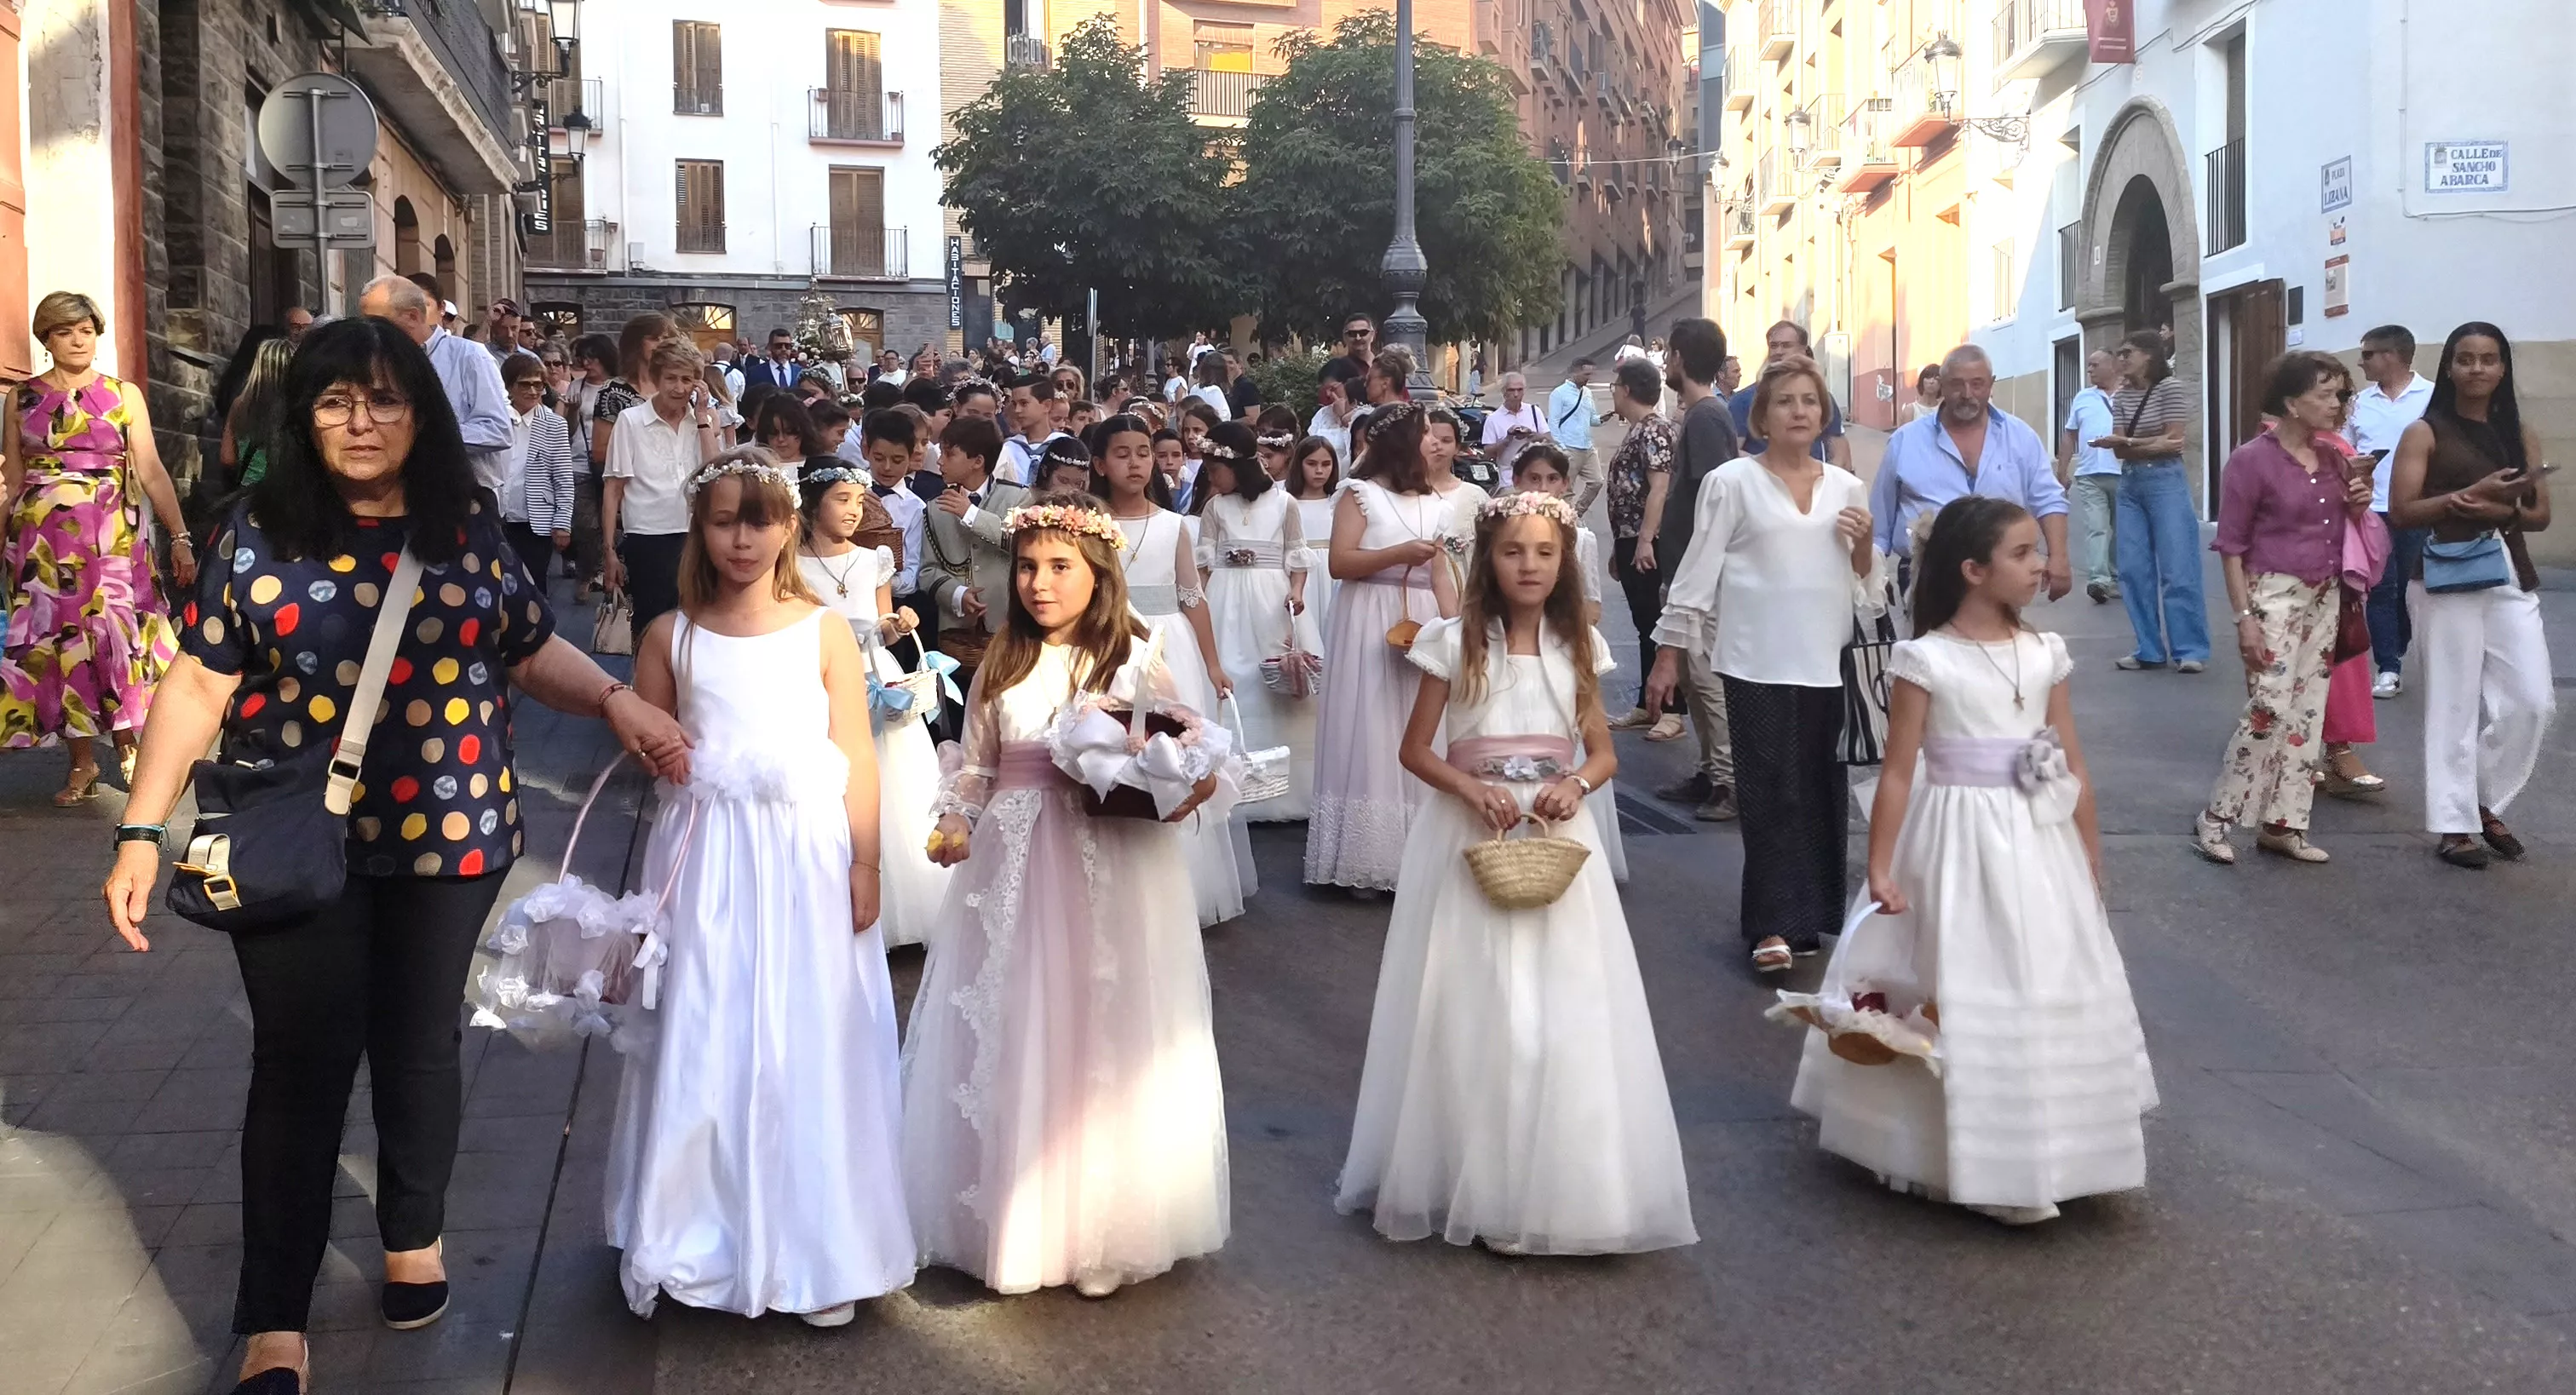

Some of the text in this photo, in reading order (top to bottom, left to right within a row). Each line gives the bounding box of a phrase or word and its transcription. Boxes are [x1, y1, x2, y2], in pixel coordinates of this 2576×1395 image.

[2451, 148, 2503, 159] CALLE DE
[2452, 161, 2496, 173] SANCHO
[2440, 174, 2489, 186] ABARCA
[2325, 186, 2349, 205] LIZANA
[951, 238, 960, 326] HABITACIONES
